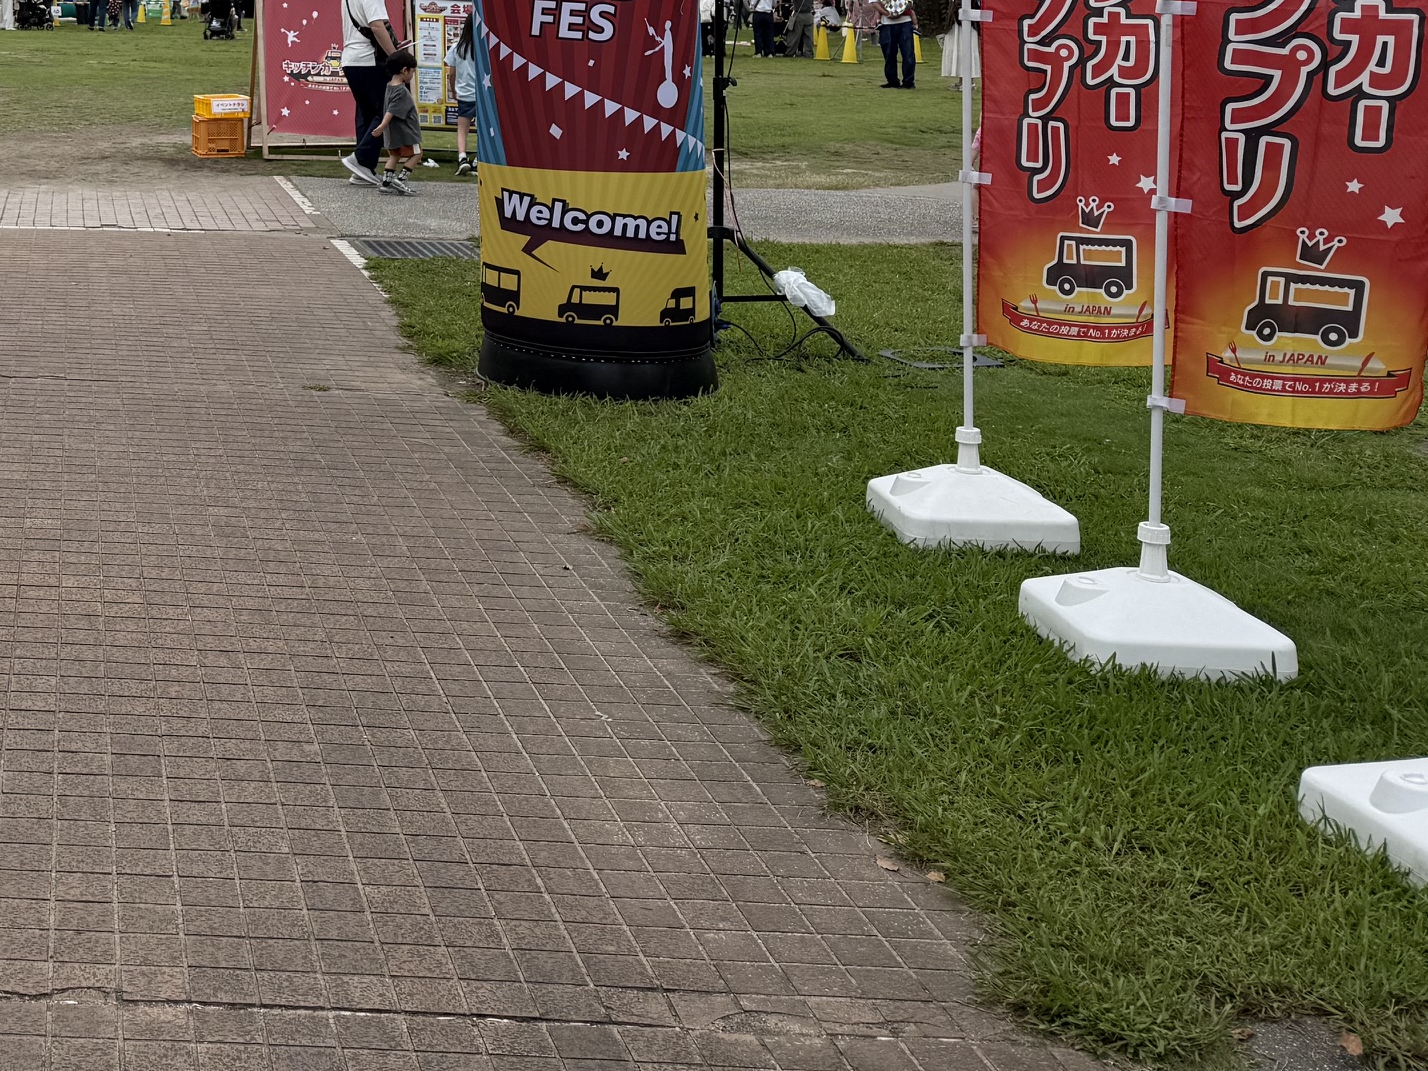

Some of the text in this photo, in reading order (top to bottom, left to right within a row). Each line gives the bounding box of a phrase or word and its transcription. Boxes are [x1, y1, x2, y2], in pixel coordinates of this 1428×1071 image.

[530, 0, 616, 41] FES
[502, 190, 679, 242] Welcome!
[1064, 303, 1112, 316] in JAPAN
[1263, 351, 1329, 366] in JAPAN
